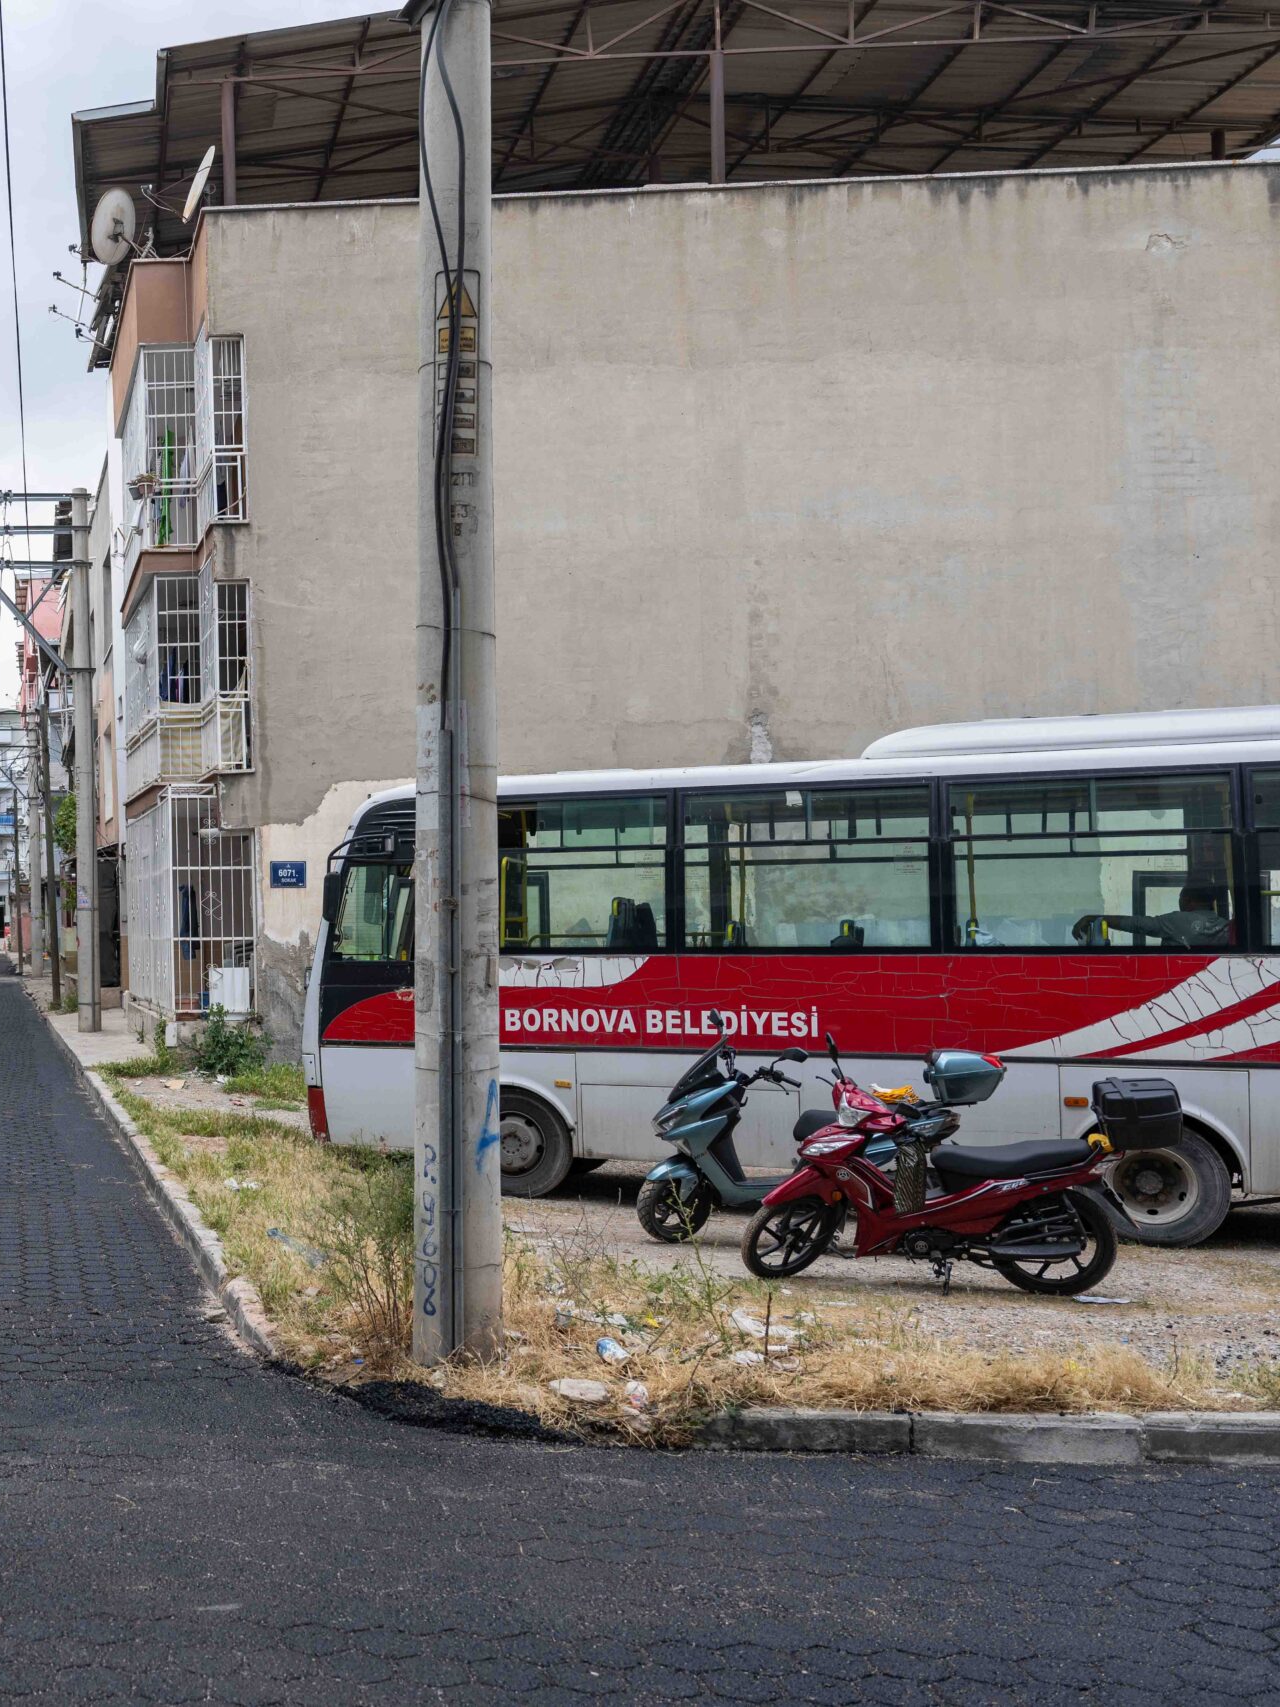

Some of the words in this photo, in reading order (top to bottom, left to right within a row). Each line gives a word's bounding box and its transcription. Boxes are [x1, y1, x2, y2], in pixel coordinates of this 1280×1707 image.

[278, 868, 299, 877] 6071.
[504, 1008, 637, 1033] BORNOVA
[646, 1004, 819, 1038] BELEDİYESİ
